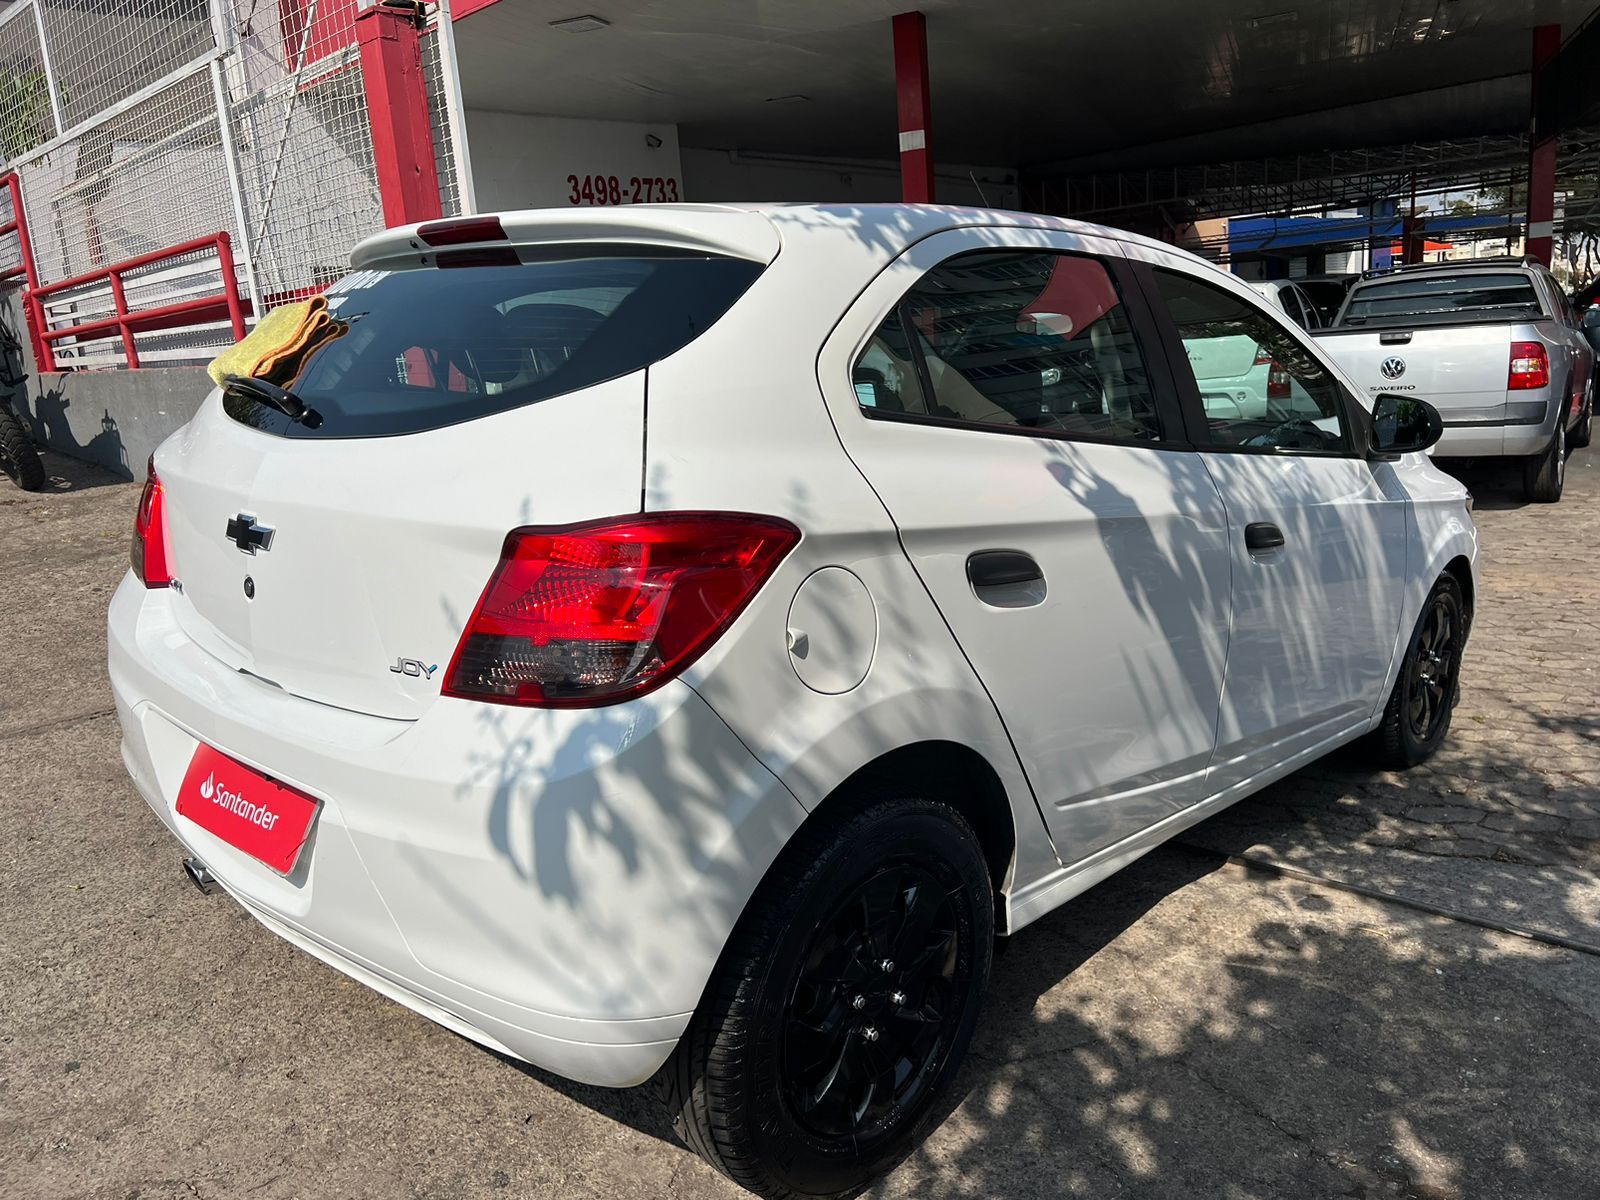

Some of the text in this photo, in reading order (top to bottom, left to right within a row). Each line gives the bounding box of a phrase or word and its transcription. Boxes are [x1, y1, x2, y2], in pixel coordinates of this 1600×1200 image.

[566, 174, 679, 205] 3498-2733
[1369, 384, 1417, 392] SAVEIRO
[389, 656, 438, 680] JOY
[213, 783, 279, 830] Santander
